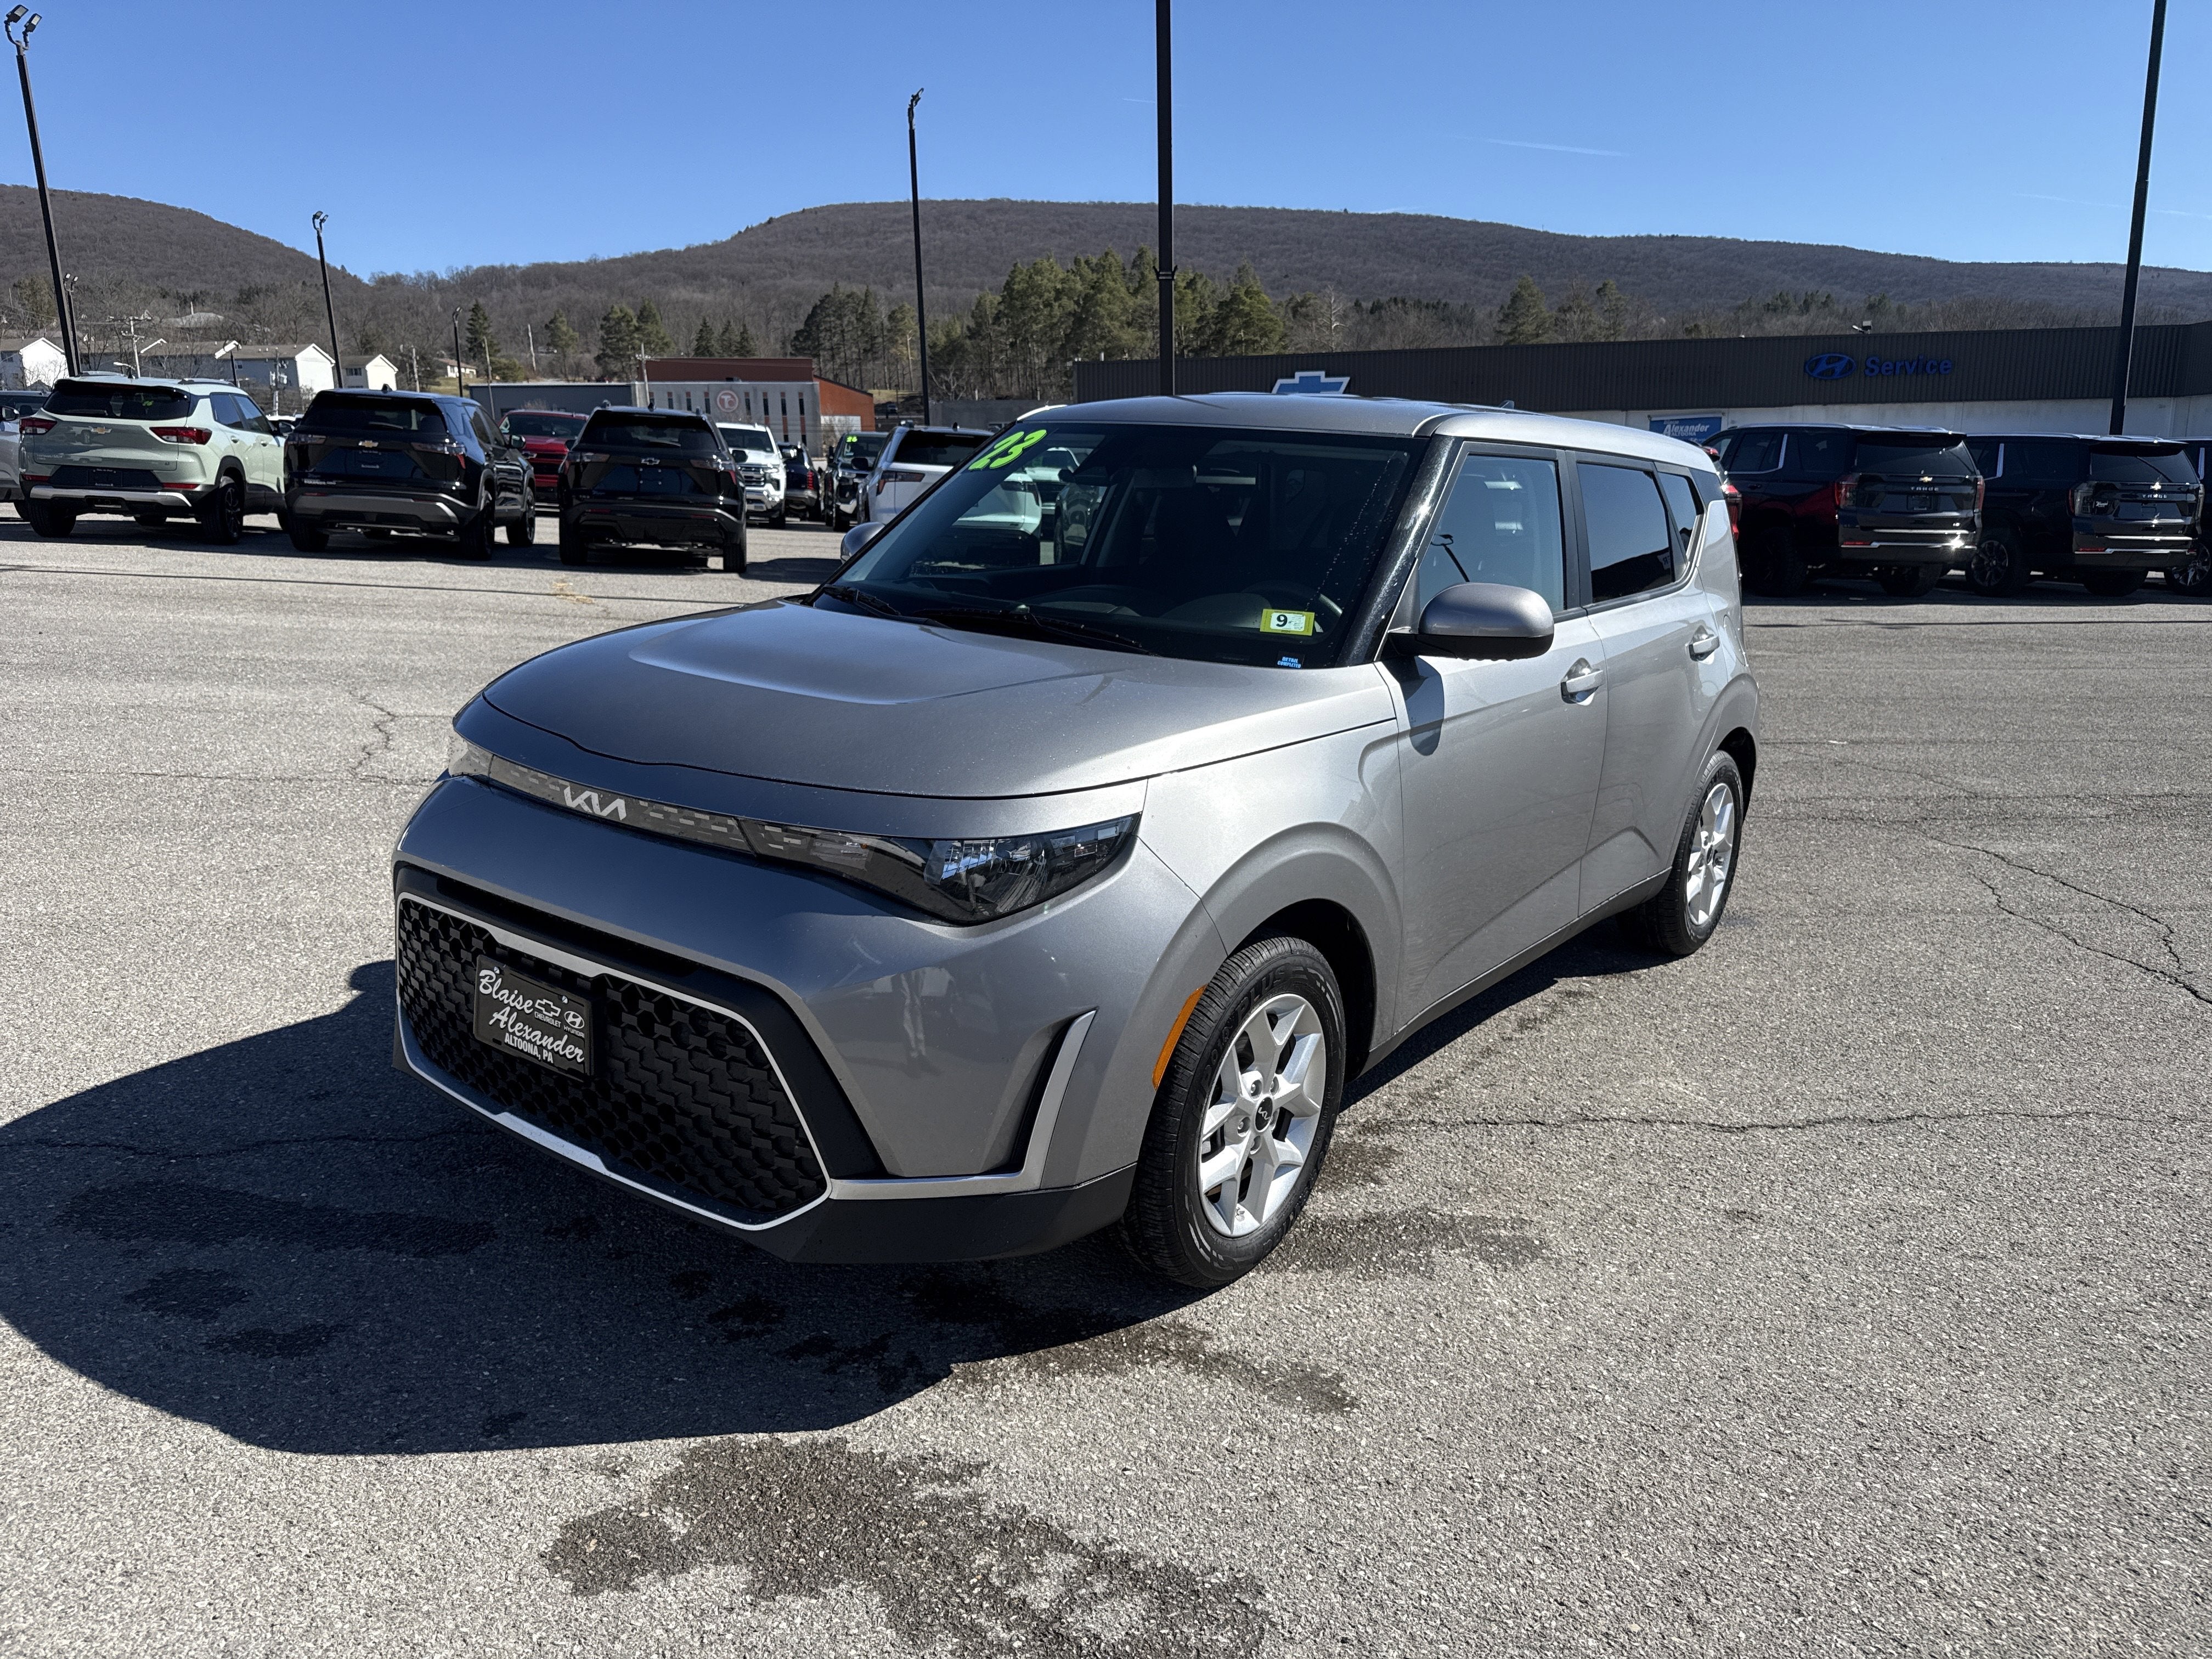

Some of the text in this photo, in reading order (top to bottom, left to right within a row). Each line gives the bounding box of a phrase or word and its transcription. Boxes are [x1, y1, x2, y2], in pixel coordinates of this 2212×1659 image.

[1865, 354, 1953, 377] Service
[1663, 424, 1710, 437] Alexander
[968, 430, 1047, 471] 23
[1276, 614, 1288, 627] 9
[564, 786, 627, 821] KIA
[479, 969, 534, 1014] Blaise
[534, 1011, 561, 1029] CHEVROLET
[563, 1025, 585, 1039] HYUNDAI
[489, 1006, 585, 1063] Alexander
[504, 1032, 554, 1064] ALTOONA, PA
